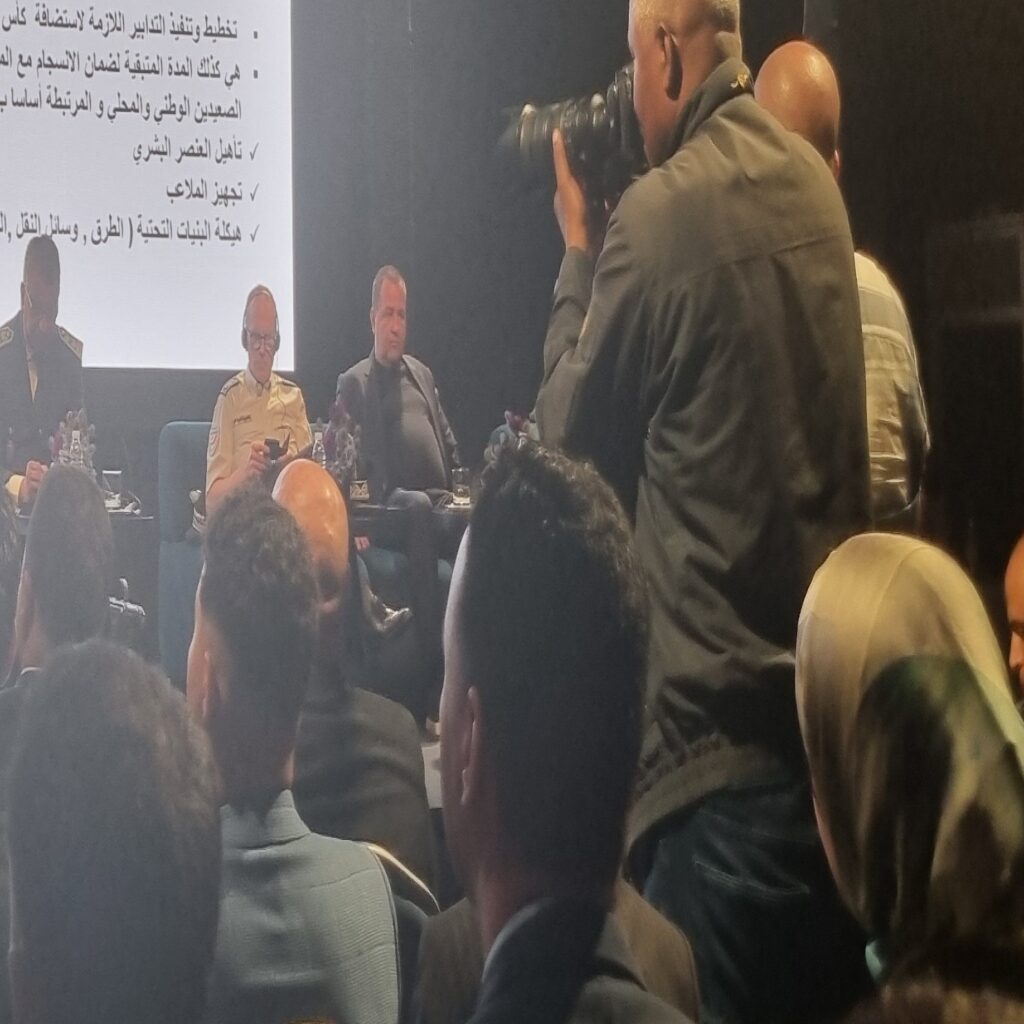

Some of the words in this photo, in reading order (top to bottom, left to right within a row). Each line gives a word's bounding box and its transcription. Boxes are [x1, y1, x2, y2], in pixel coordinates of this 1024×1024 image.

[2, 0, 26, 32] كأس
[35, 2, 84, 32] لاستضافة
[88, 7, 125, 38] اللازمة
[129, 13, 165, 40] التدابير
[169, 11, 200, 43] وتنفيذ
[203, 15, 237, 39] تخطيط
[17, 53, 32, 79] مع
[36, 49, 80, 78] الانسجام
[84, 52, 120, 79] لضمان
[124, 49, 163, 81] المتبقية
[168, 56, 192, 78] المدة
[197, 56, 221, 78] كذلك
[224, 64, 240, 89] هي
[11, 83, 42, 109] أساسا
[46, 84, 91, 116] المرتبطة
[96, 100, 104, 119] و
[107, 91, 150, 123] والمحلي
[153, 93, 190, 125] الوطني
[194, 98, 241, 124] الصعيدين
[133, 134, 171, 165] البشري
[175, 137, 211, 164] العنصر
[215, 136, 242, 164] تأهيل
[166, 178, 207, 204] الملاعب
[211, 182, 242, 208] تجهيز
[16, 212, 41, 239] النقل
[91, 214, 124, 245] الطرق
[137, 214, 172, 243] التحتية
[177, 219, 211, 246] البنيات
[215, 217, 242, 247] هيكلة
